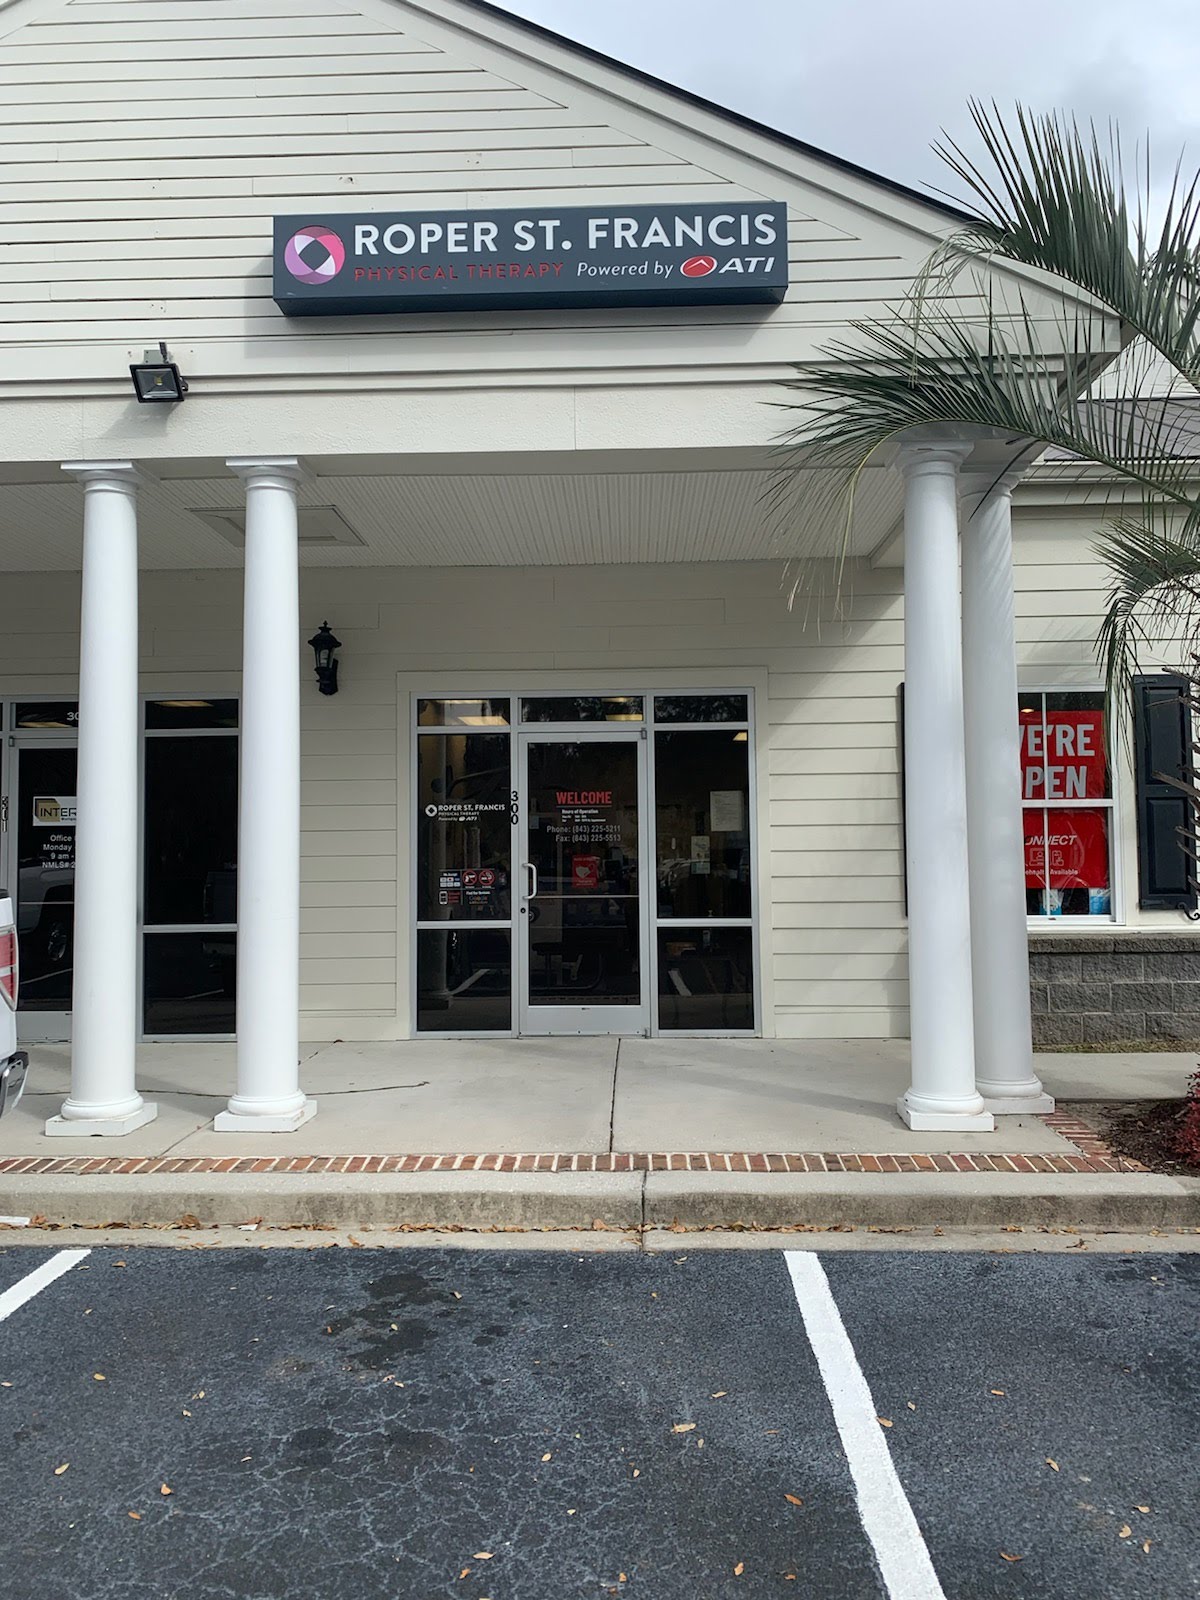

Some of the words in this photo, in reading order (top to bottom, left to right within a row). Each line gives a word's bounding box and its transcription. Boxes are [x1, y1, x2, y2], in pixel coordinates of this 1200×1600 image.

[353, 220, 499, 256] ROPER
[513, 218, 573, 252] ST.
[587, 213, 777, 250] FRANCIS
[353, 264, 459, 282] PHYSICAL
[466, 262, 565, 280] THERAPY
[577, 260, 648, 277] Powered
[652, 261, 674, 279] by
[718, 256, 776, 274] ATI
[1021, 765, 1088, 799] PEN
[556, 791, 612, 804] WELCOME
[510, 790, 519, 825] 300
[546, 825, 571, 833] Phone:
[572, 825, 590, 834] (843)
[591, 825, 621, 833] 225-5211
[50, 834, 72, 842] Office
[555, 834, 571, 842] Fax:
[572, 834, 590, 843] (843)
[590, 834, 621, 842] 225-5513
[43, 843, 73, 852] Monday
[50, 852, 56, 860] 9
[42, 861, 70, 869] NMLS#
